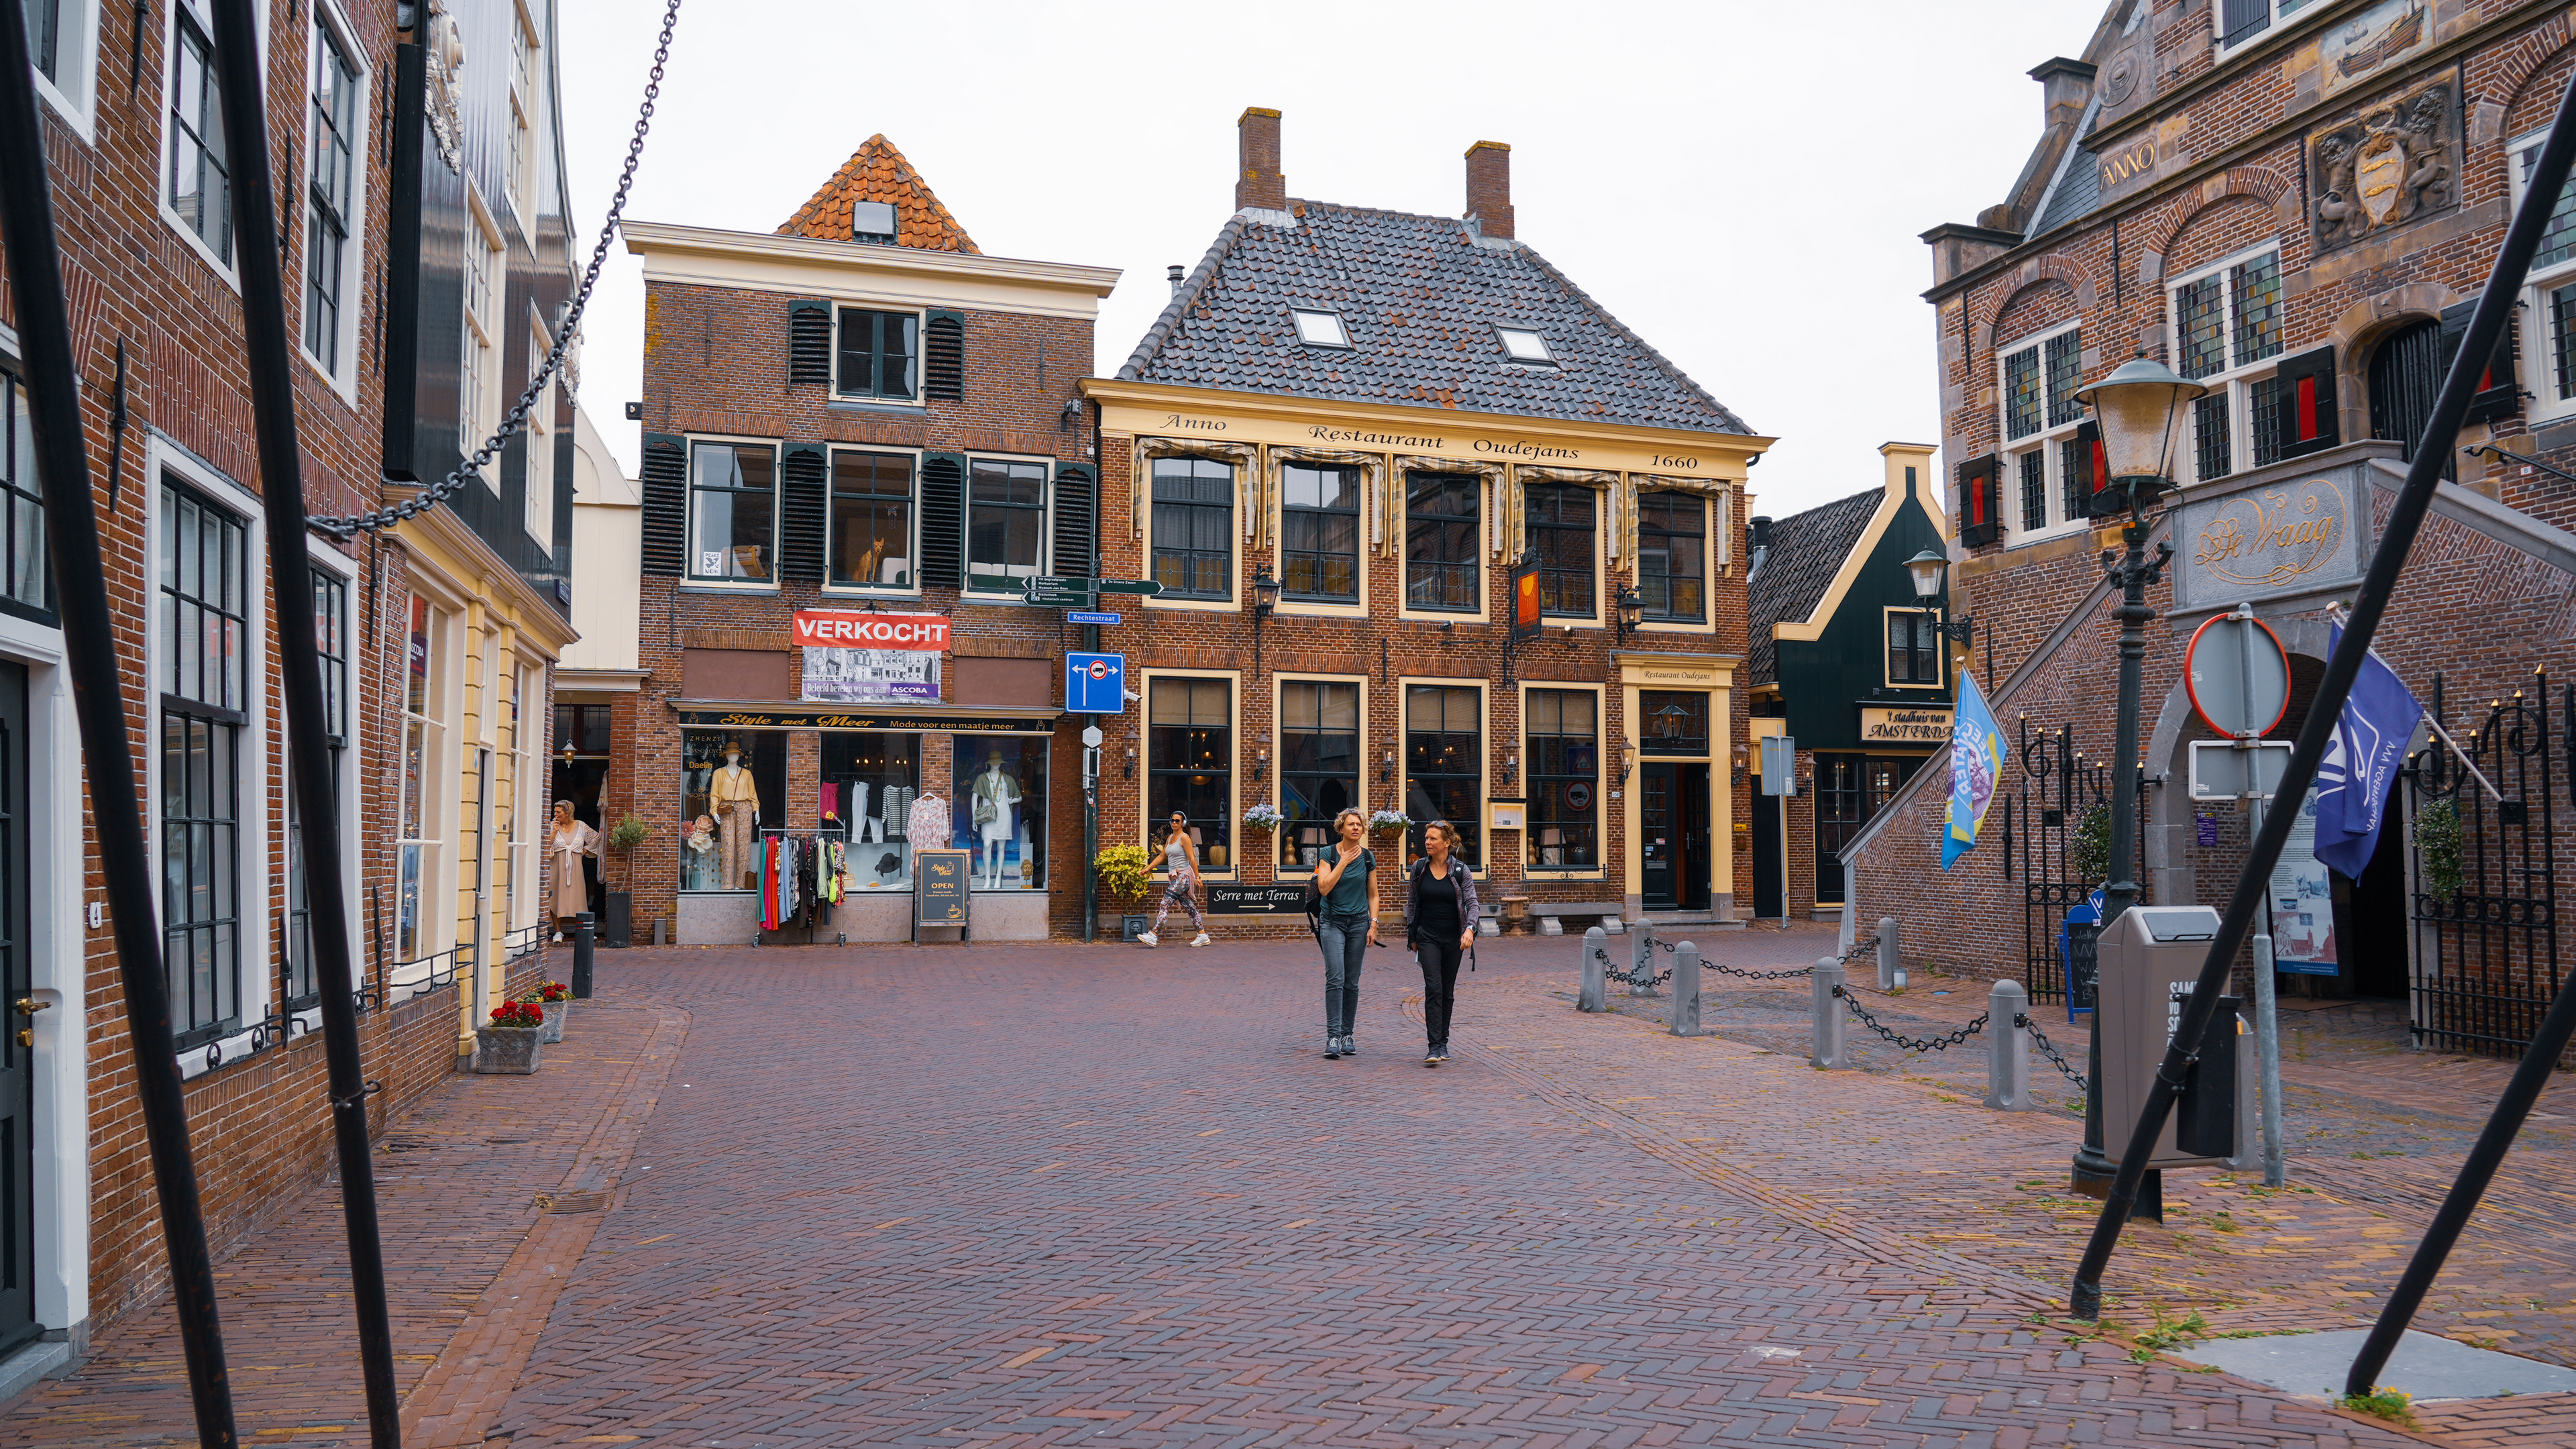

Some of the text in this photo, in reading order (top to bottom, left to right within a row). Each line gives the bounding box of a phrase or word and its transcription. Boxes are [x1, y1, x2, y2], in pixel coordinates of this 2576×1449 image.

[2100, 143, 2155, 191] ANNO
[1159, 414, 1698, 469] Anno Restaurant Oudejans 1660
[1073, 614, 1116, 623] Rechtestraat
[797, 619, 947, 642] VERKOCHT
[1644, 670, 1711, 682] Restaurant Oudejans
[807, 683, 886, 694] Beleefd bevelen wij ons aan
[720, 713, 772, 725] Style
[816, 715, 875, 727] Meer
[959, 722, 989, 731] maatje
[1888, 710, 1946, 722] 't stadhuis van
[1868, 722, 1954, 739] AMSTERDA
[689, 761, 713, 769] Daelin
[931, 863, 946, 872] Style
[1214, 889, 1299, 902] Serre met Terras
[2074, 929, 2100, 939] Welko
